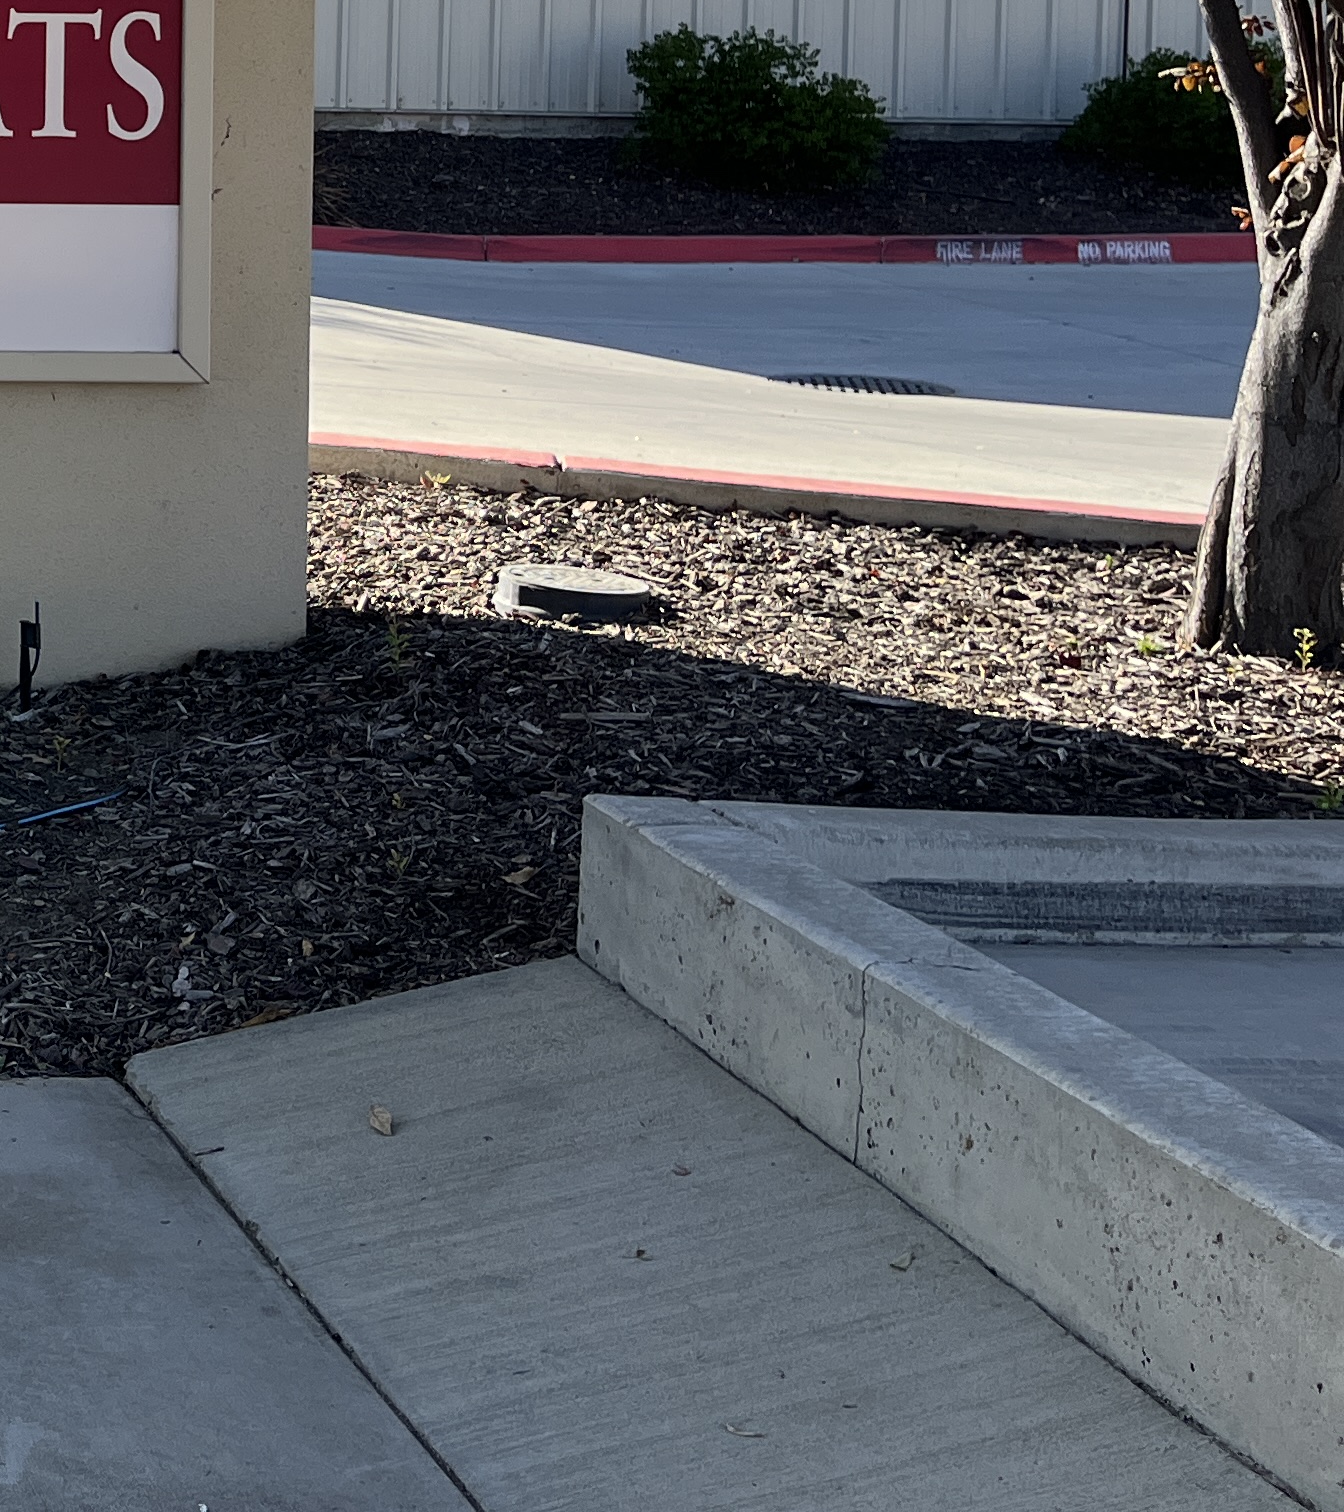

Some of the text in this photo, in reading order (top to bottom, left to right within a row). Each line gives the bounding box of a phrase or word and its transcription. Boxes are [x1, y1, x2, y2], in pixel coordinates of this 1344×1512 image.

[936, 241, 1023, 263] FIRE LANE
[1077, 240, 1171, 262] NO PARKING
